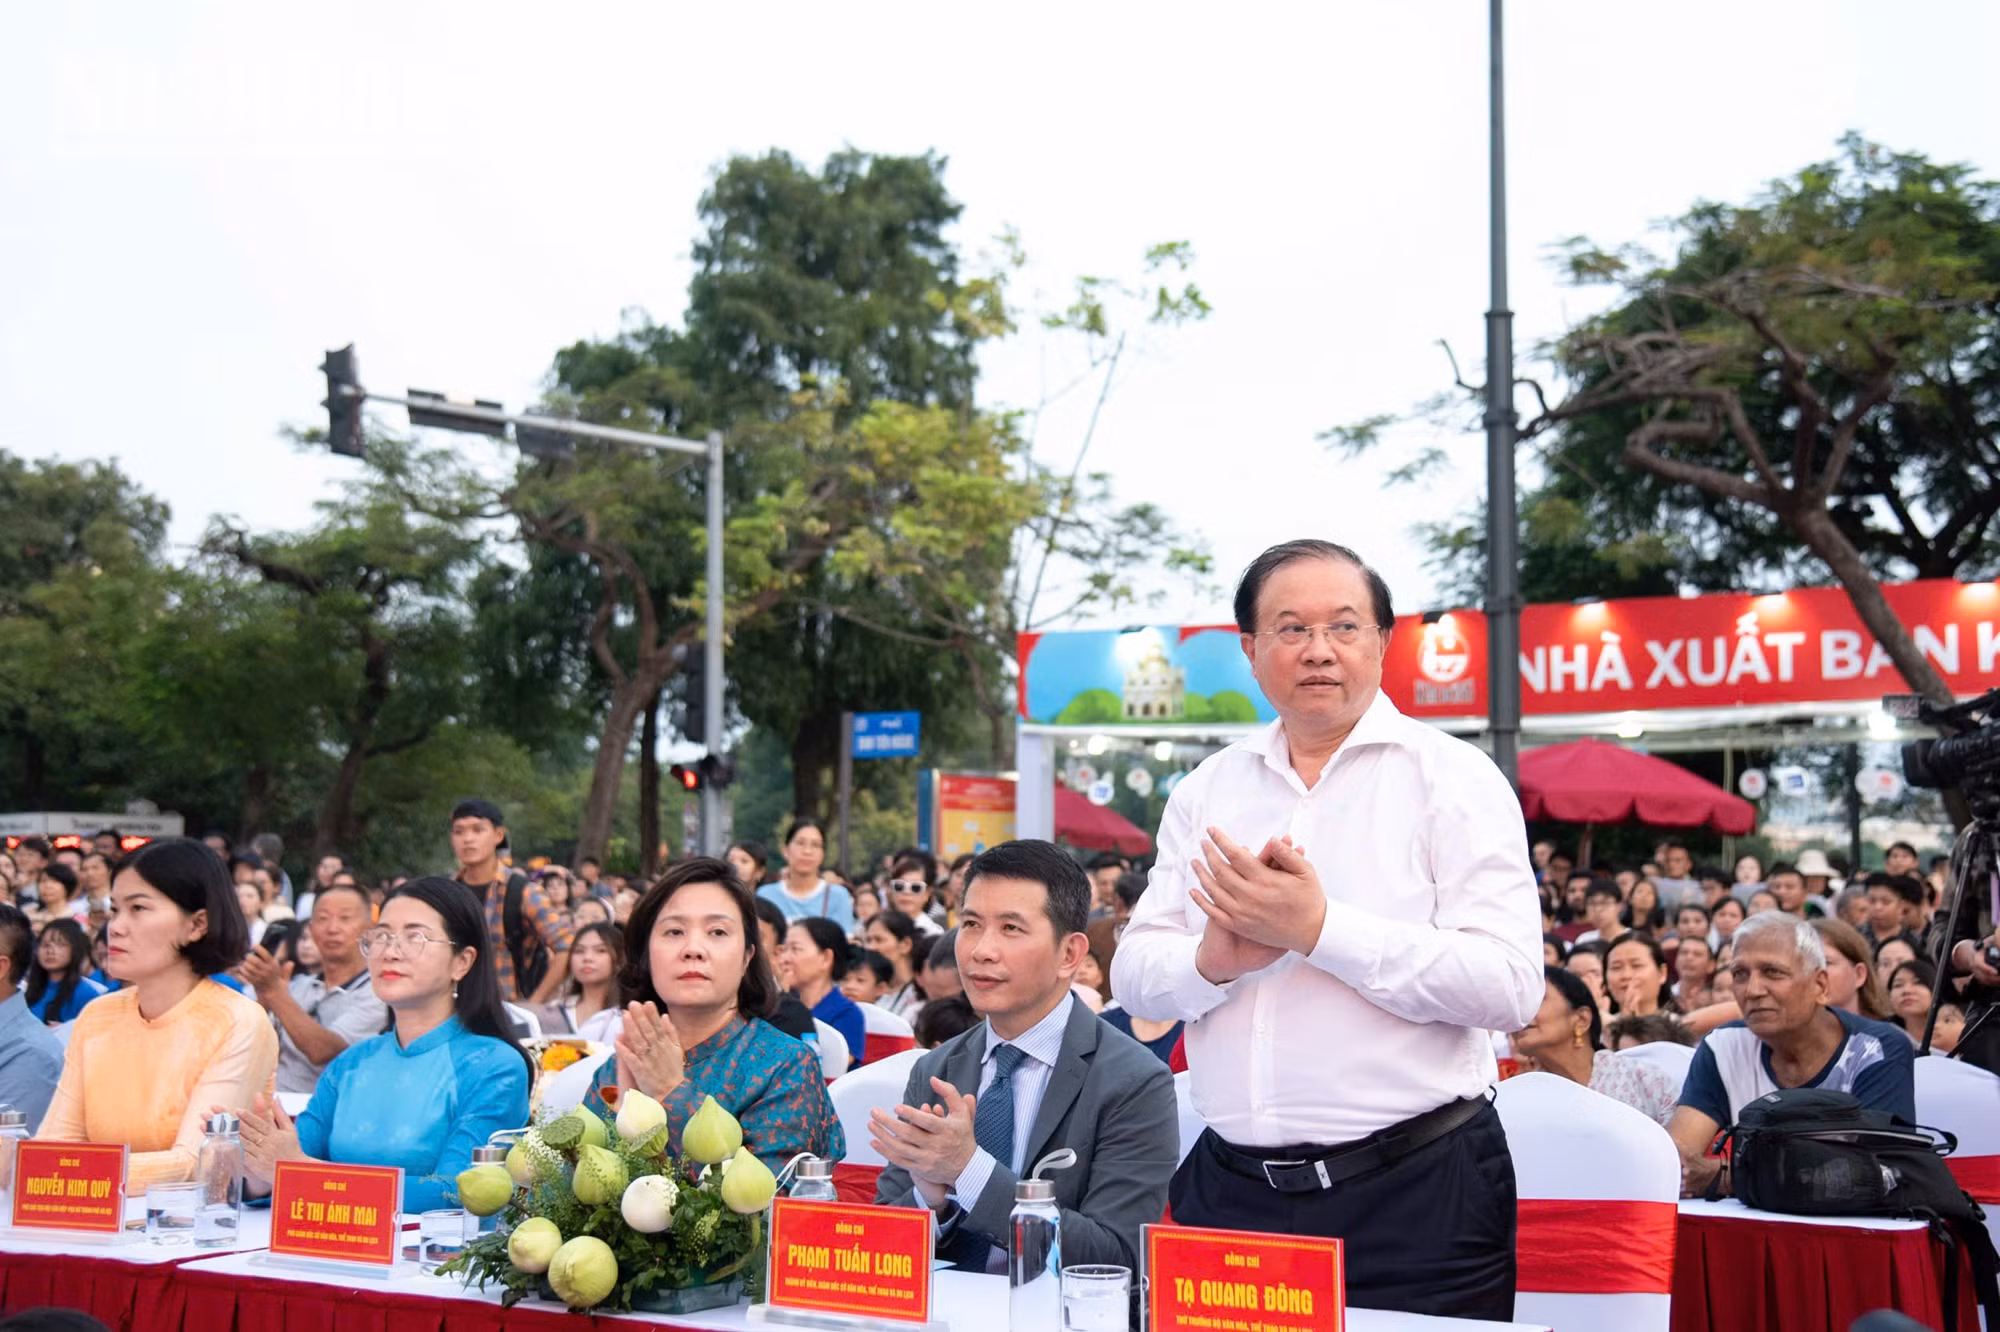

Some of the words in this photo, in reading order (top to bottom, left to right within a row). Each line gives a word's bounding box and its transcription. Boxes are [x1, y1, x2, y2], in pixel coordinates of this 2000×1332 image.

[1518, 630, 1634, 693] NHÀ
[1645, 611, 1806, 690] XUẤT
[67, 1178, 88, 1197] KIM
[290, 1198, 303, 1220] LÊ
[306, 1202, 324, 1226] THỊ
[327, 1200, 351, 1224] ÁNH
[353, 1206, 377, 1227] MAI
[788, 1244, 830, 1273] PHẠM
[834, 1242, 871, 1274] TUẤN
[875, 1252, 912, 1279] LONG
[1175, 1278, 1195, 1308] TẠ
[1200, 1280, 1258, 1309] QUANG
[1263, 1283, 1313, 1315] ĐÔNG
